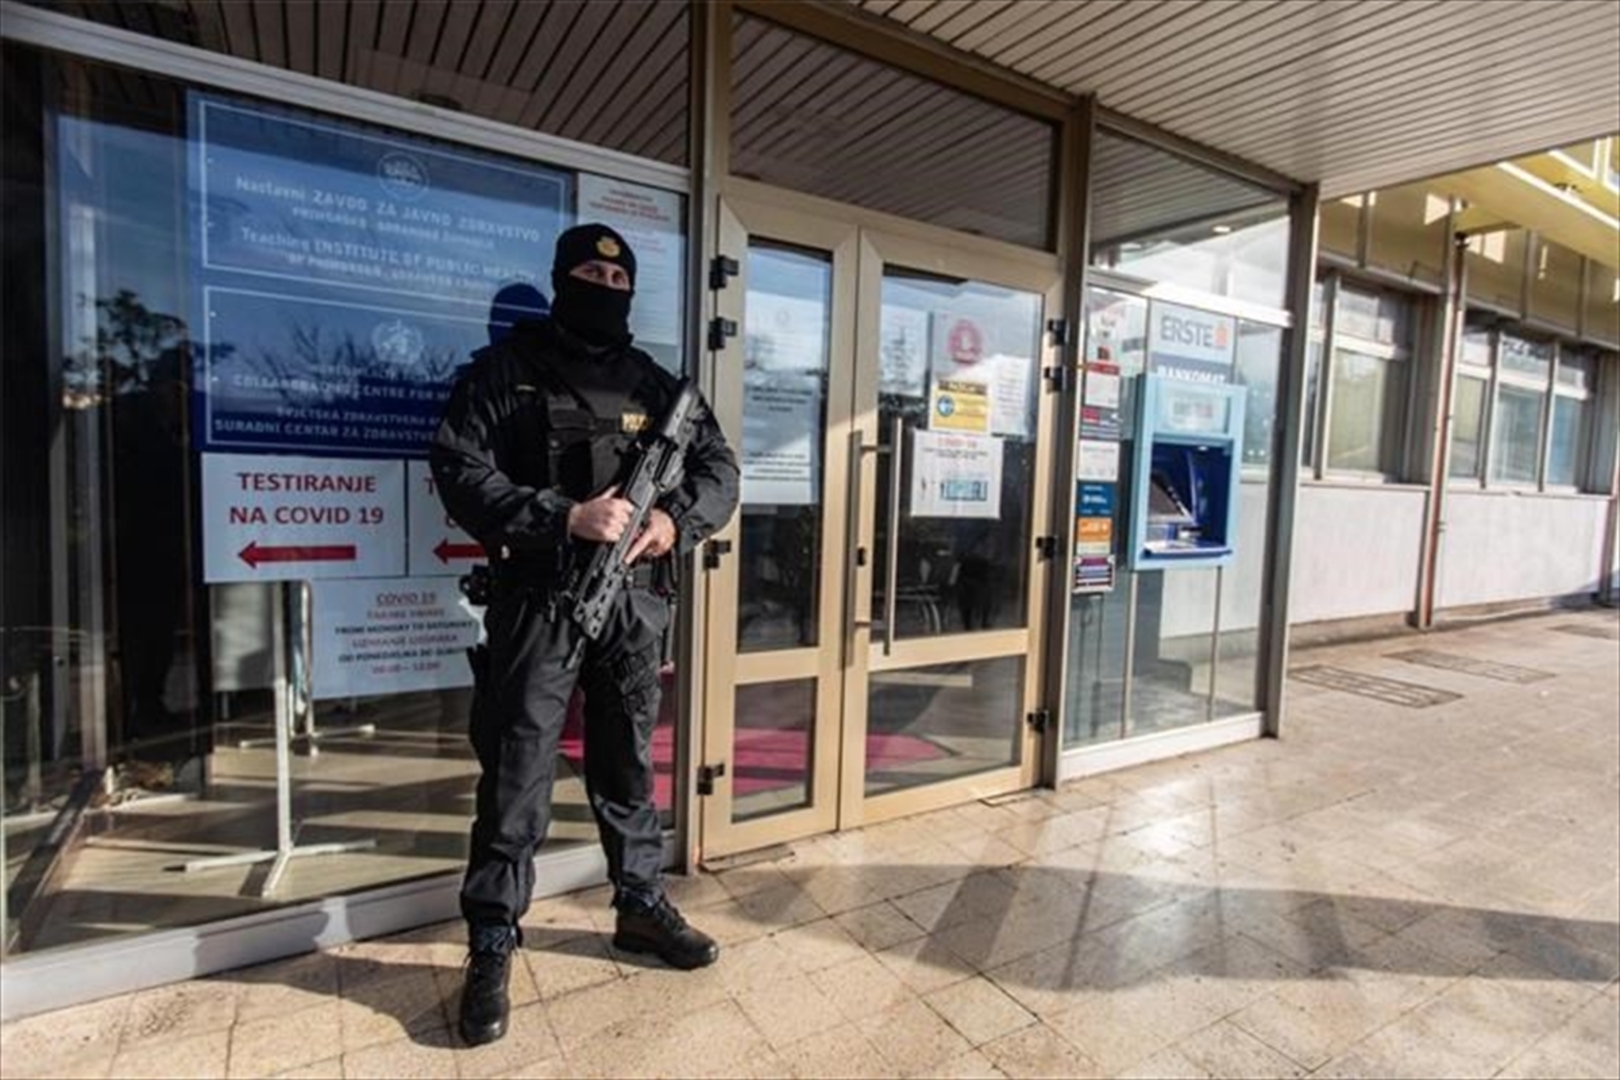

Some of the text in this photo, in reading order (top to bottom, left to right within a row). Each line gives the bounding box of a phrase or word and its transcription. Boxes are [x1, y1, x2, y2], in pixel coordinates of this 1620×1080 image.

[235, 175, 306, 201] Nastavni
[312, 188, 368, 212] ZAVOD
[376, 200, 398, 218] ZA
[401, 205, 452, 227] JAVNO
[458, 215, 541, 244] ZDRAVSTVO
[241, 226, 310, 253] Teaching
[314, 238, 399, 265] INSTITUTE
[1160, 315, 1213, 347] ERSTE
[214, 419, 281, 434] SURADNI
[284, 422, 339, 437] CENTAR
[342, 427, 359, 438] ZA
[236, 472, 377, 493] TESTIRANJE
[230, 506, 384, 524] NA COVID 19
[376, 591, 437, 607] COVID 19
